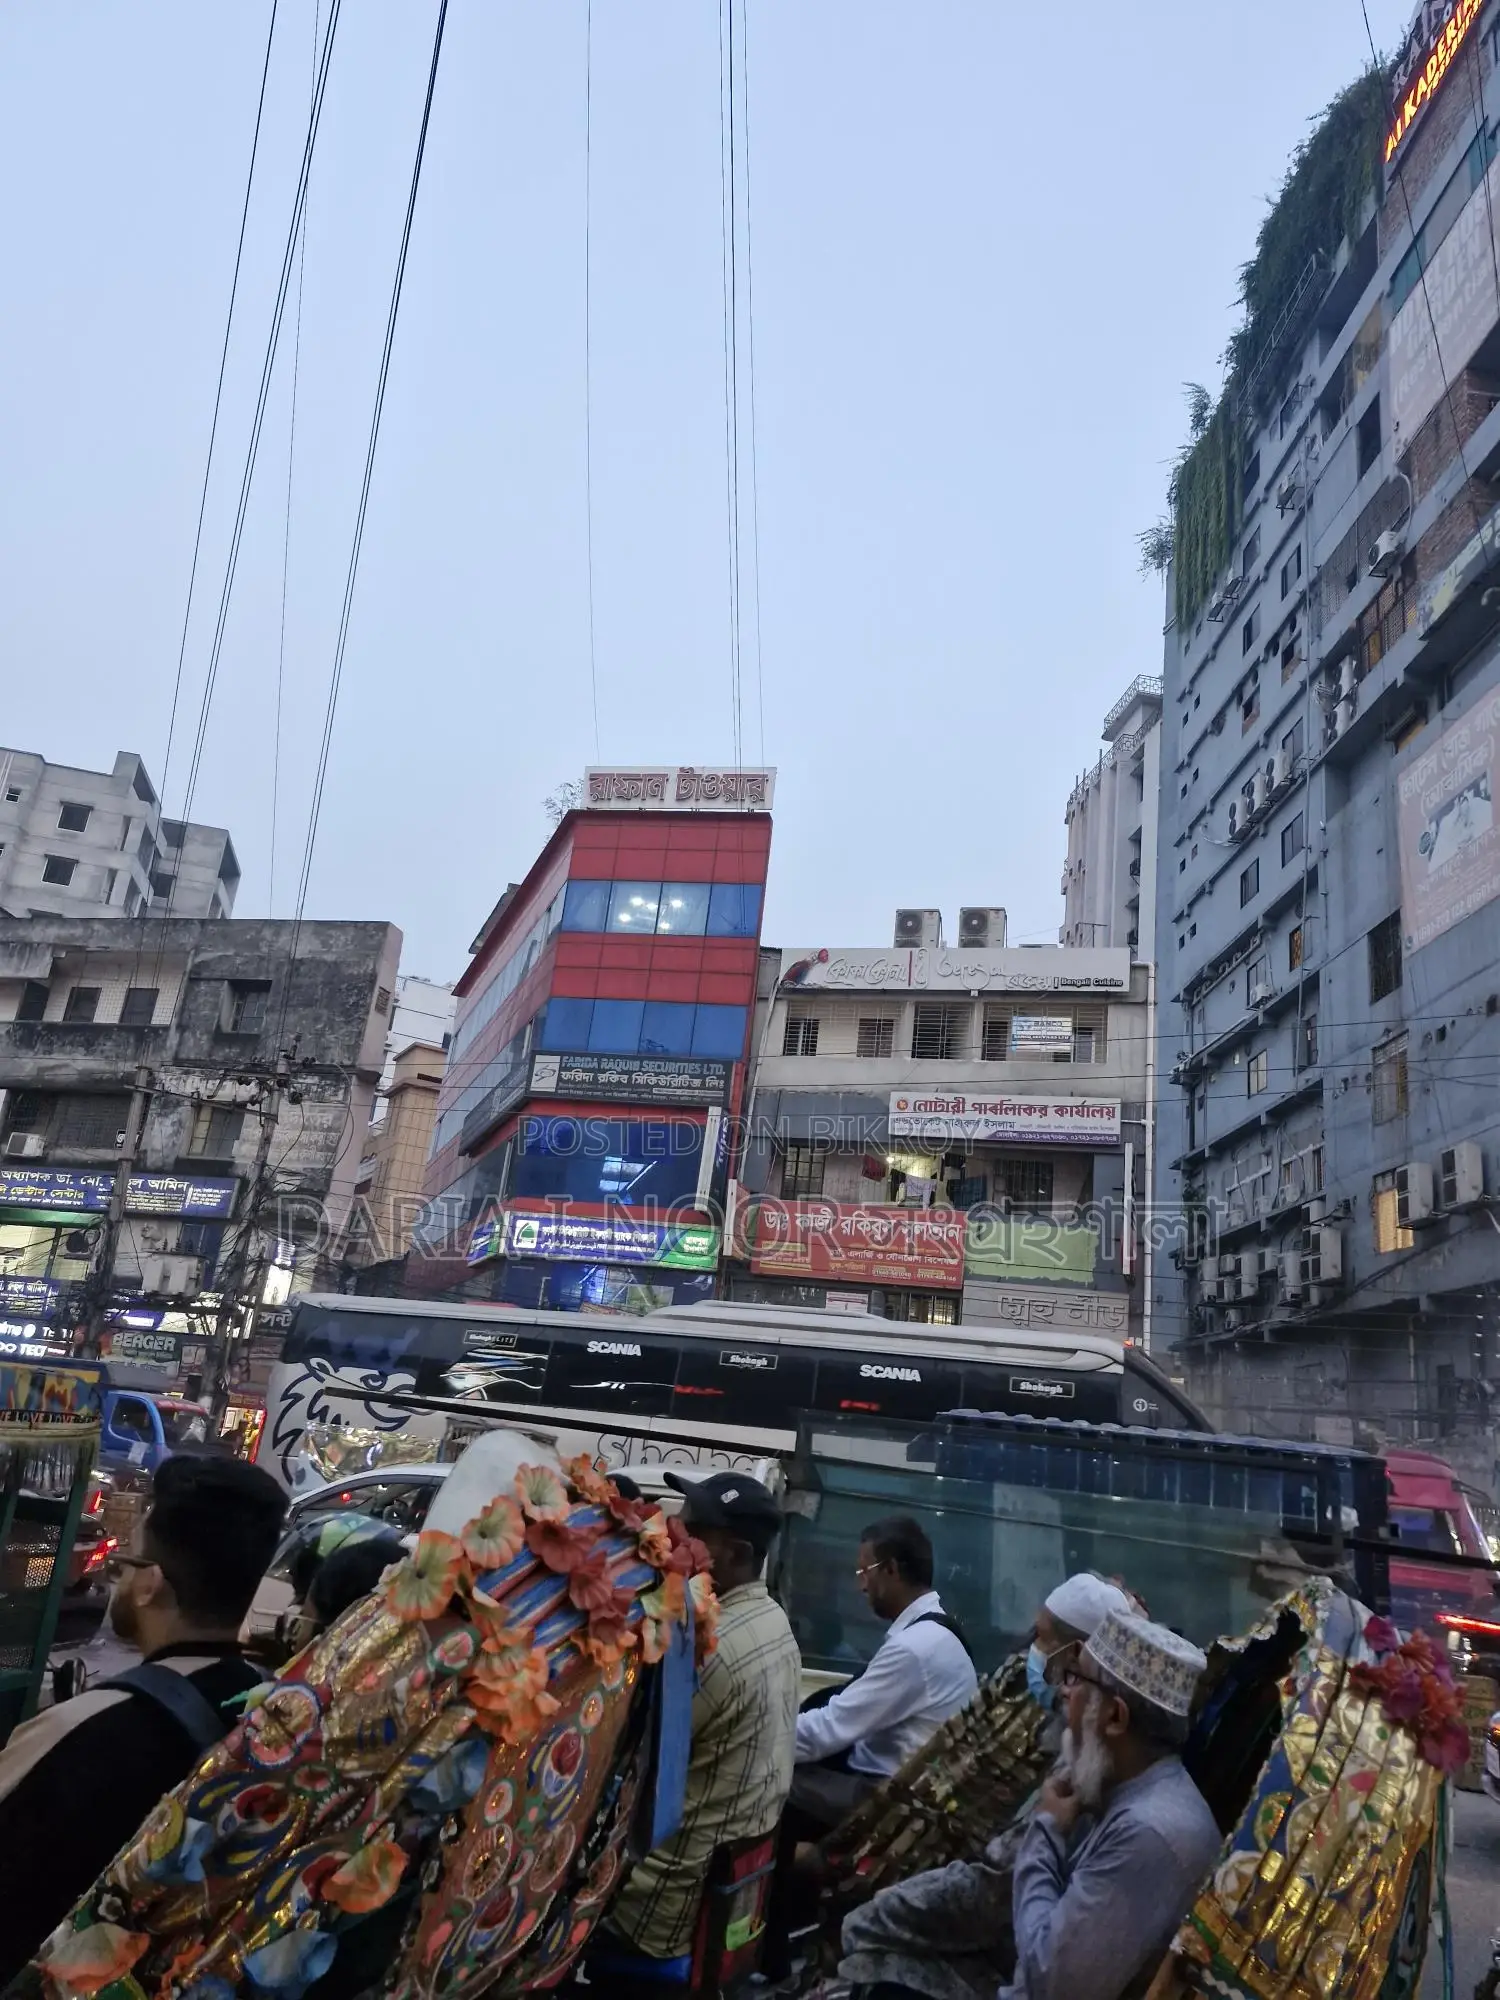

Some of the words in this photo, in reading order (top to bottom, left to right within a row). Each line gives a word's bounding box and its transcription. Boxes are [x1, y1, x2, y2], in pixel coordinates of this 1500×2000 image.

[675, 767, 769, 802] টাওয়ার
[1060, 977, 1091, 988] Bengali
[1093, 978, 1124, 987] Cuisine
[561, 1056, 598, 1069] FARIDA
[600, 1058, 640, 1072] RAQUIB
[642, 1061, 701, 1075] SECURITIES
[560, 1068, 594, 1082] ফরিদা
[597, 1070, 629, 1084] রকিব
[632, 1072, 703, 1088] সিকিউরিটিজ
[912, 1097, 966, 1115] নোটারী
[1052, 1100, 1116, 1121] কার্যালয়
[983, 1118, 1016, 1130] ইসলাম
[1, 1170, 52, 1182] অধ্যাপক
[55, 1174, 74, 1185] ডা.
[80, 1175, 104, 1187] মো.
[148, 1177, 190, 1192] আমিন
[11, 1186, 46, 1197] ডেন্টাল
[50, 1188, 85, 1199] সেন্টার
[764, 1210, 789, 1230] ডাঃ
[795, 1208, 835, 1234] কাজী
[841, 1210, 895, 1243] রকিবুল
[900, 1219, 962, 1247] সুলতান
[112, 1333, 177, 1352] BERGER
[586, 1340, 642, 1357] SCANIA
[729, 1355, 768, 1366] Shohagh
[859, 1364, 922, 1382] SCANIA
[1019, 1381, 1063, 1395] Shohagh
